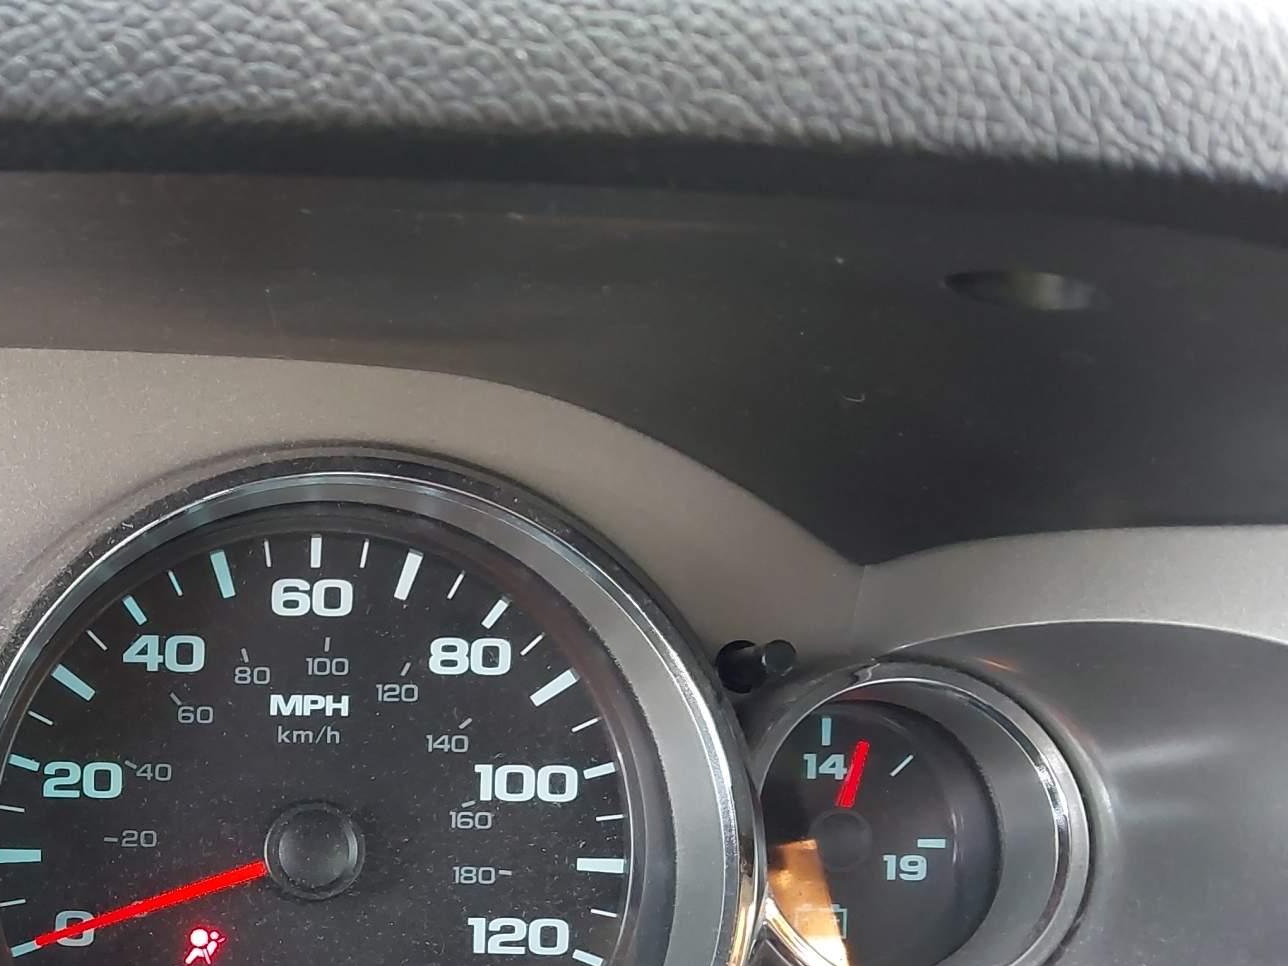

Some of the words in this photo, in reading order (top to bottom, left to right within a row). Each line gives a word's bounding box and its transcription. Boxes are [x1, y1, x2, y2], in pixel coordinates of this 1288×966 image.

[270, 578, 353, 617] 60
[122, 633, 206, 673] 40
[428, 637, 512, 676] 80
[234, 666, 271, 685] 80
[306, 657, 349, 676] 100
[375, 684, 418, 702] 120
[177, 706, 213, 725] 60
[269, 694, 349, 717] MPH
[277, 725, 341, 745] km/h
[426, 734, 469, 753] 140
[135, 763, 172, 781] 40
[803, 753, 848, 780] 14
[41, 761, 123, 800] 20
[474, 764, 578, 802] 100
[449, 811, 492, 829] 160
[121, 830, 157, 847] 20
[452, 866, 496, 885] 180
[882, 854, 928, 881] 19
[467, 917, 569, 956] 120
